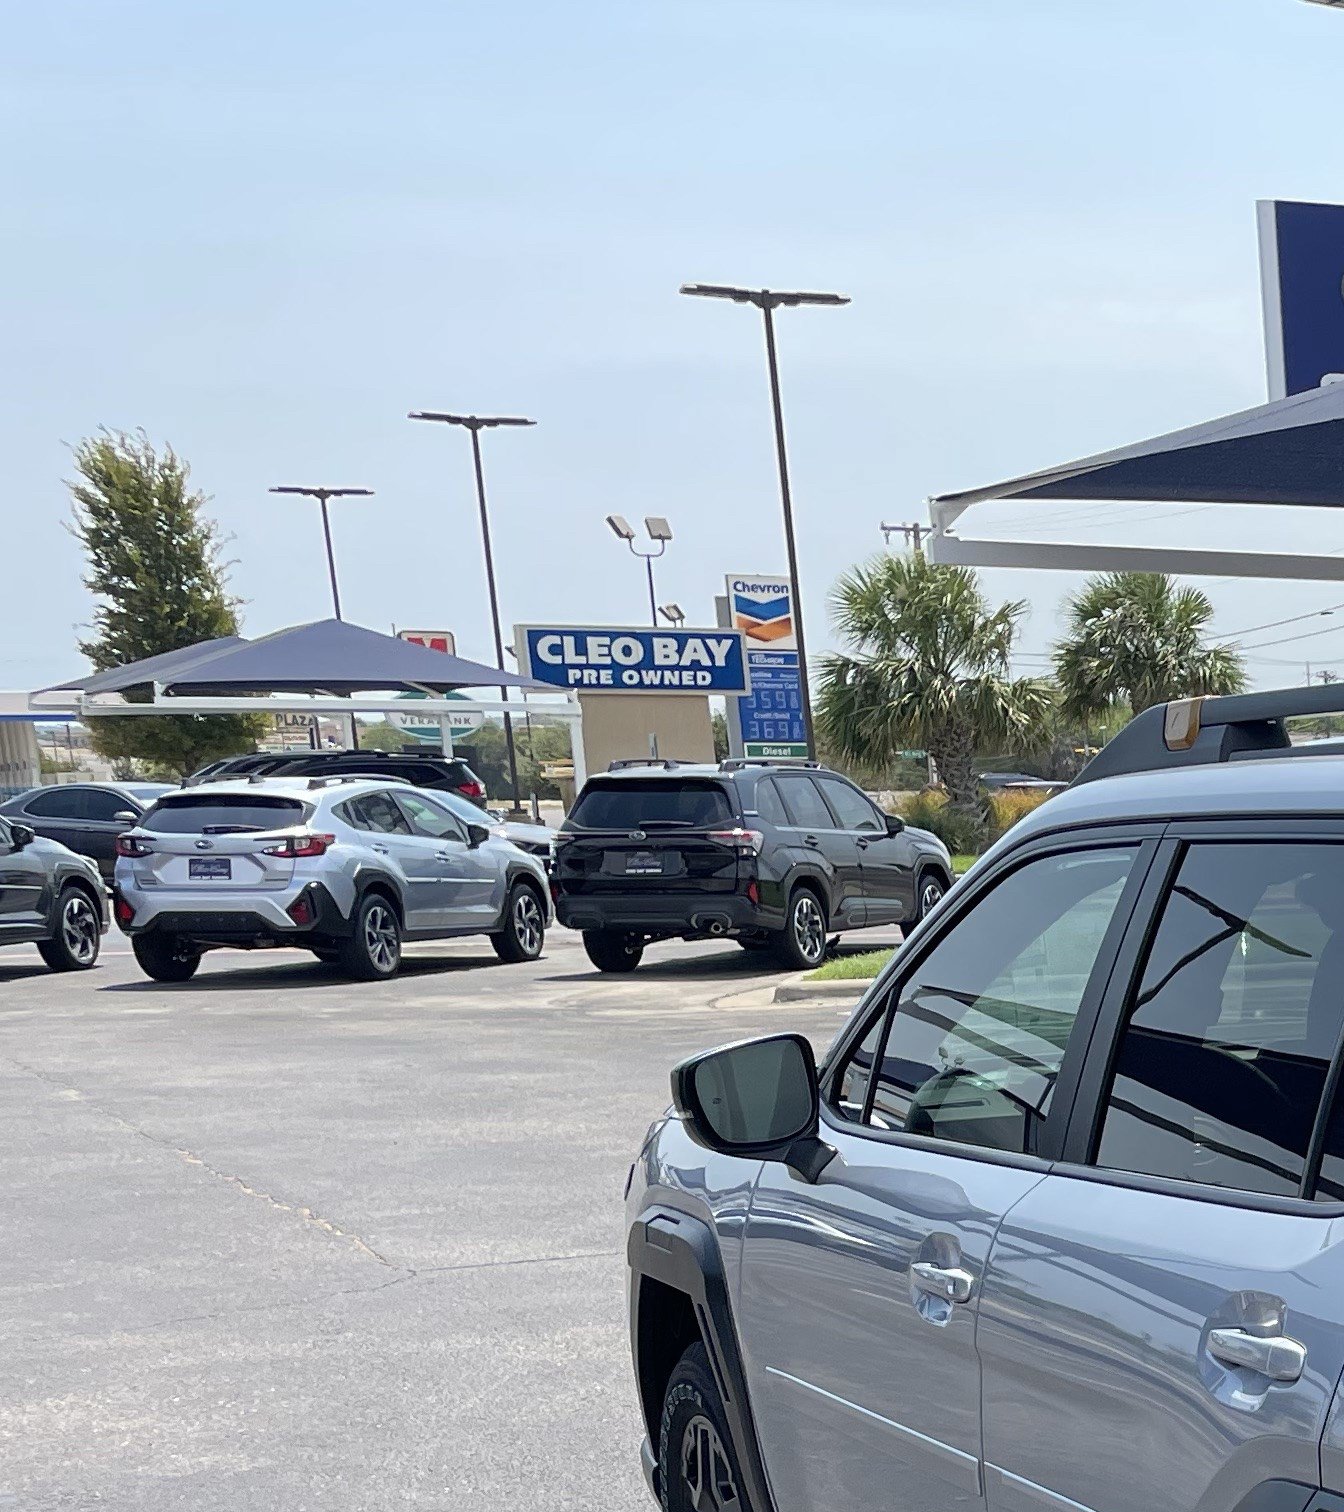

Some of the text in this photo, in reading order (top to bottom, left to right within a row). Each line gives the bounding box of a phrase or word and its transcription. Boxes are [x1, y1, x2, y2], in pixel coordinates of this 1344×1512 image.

[732, 580, 789, 594] Chevron
[536, 634, 734, 667] CLEO BAY
[567, 668, 713, 687] PRE OWNED
[762, 746, 792, 756] Diesel
